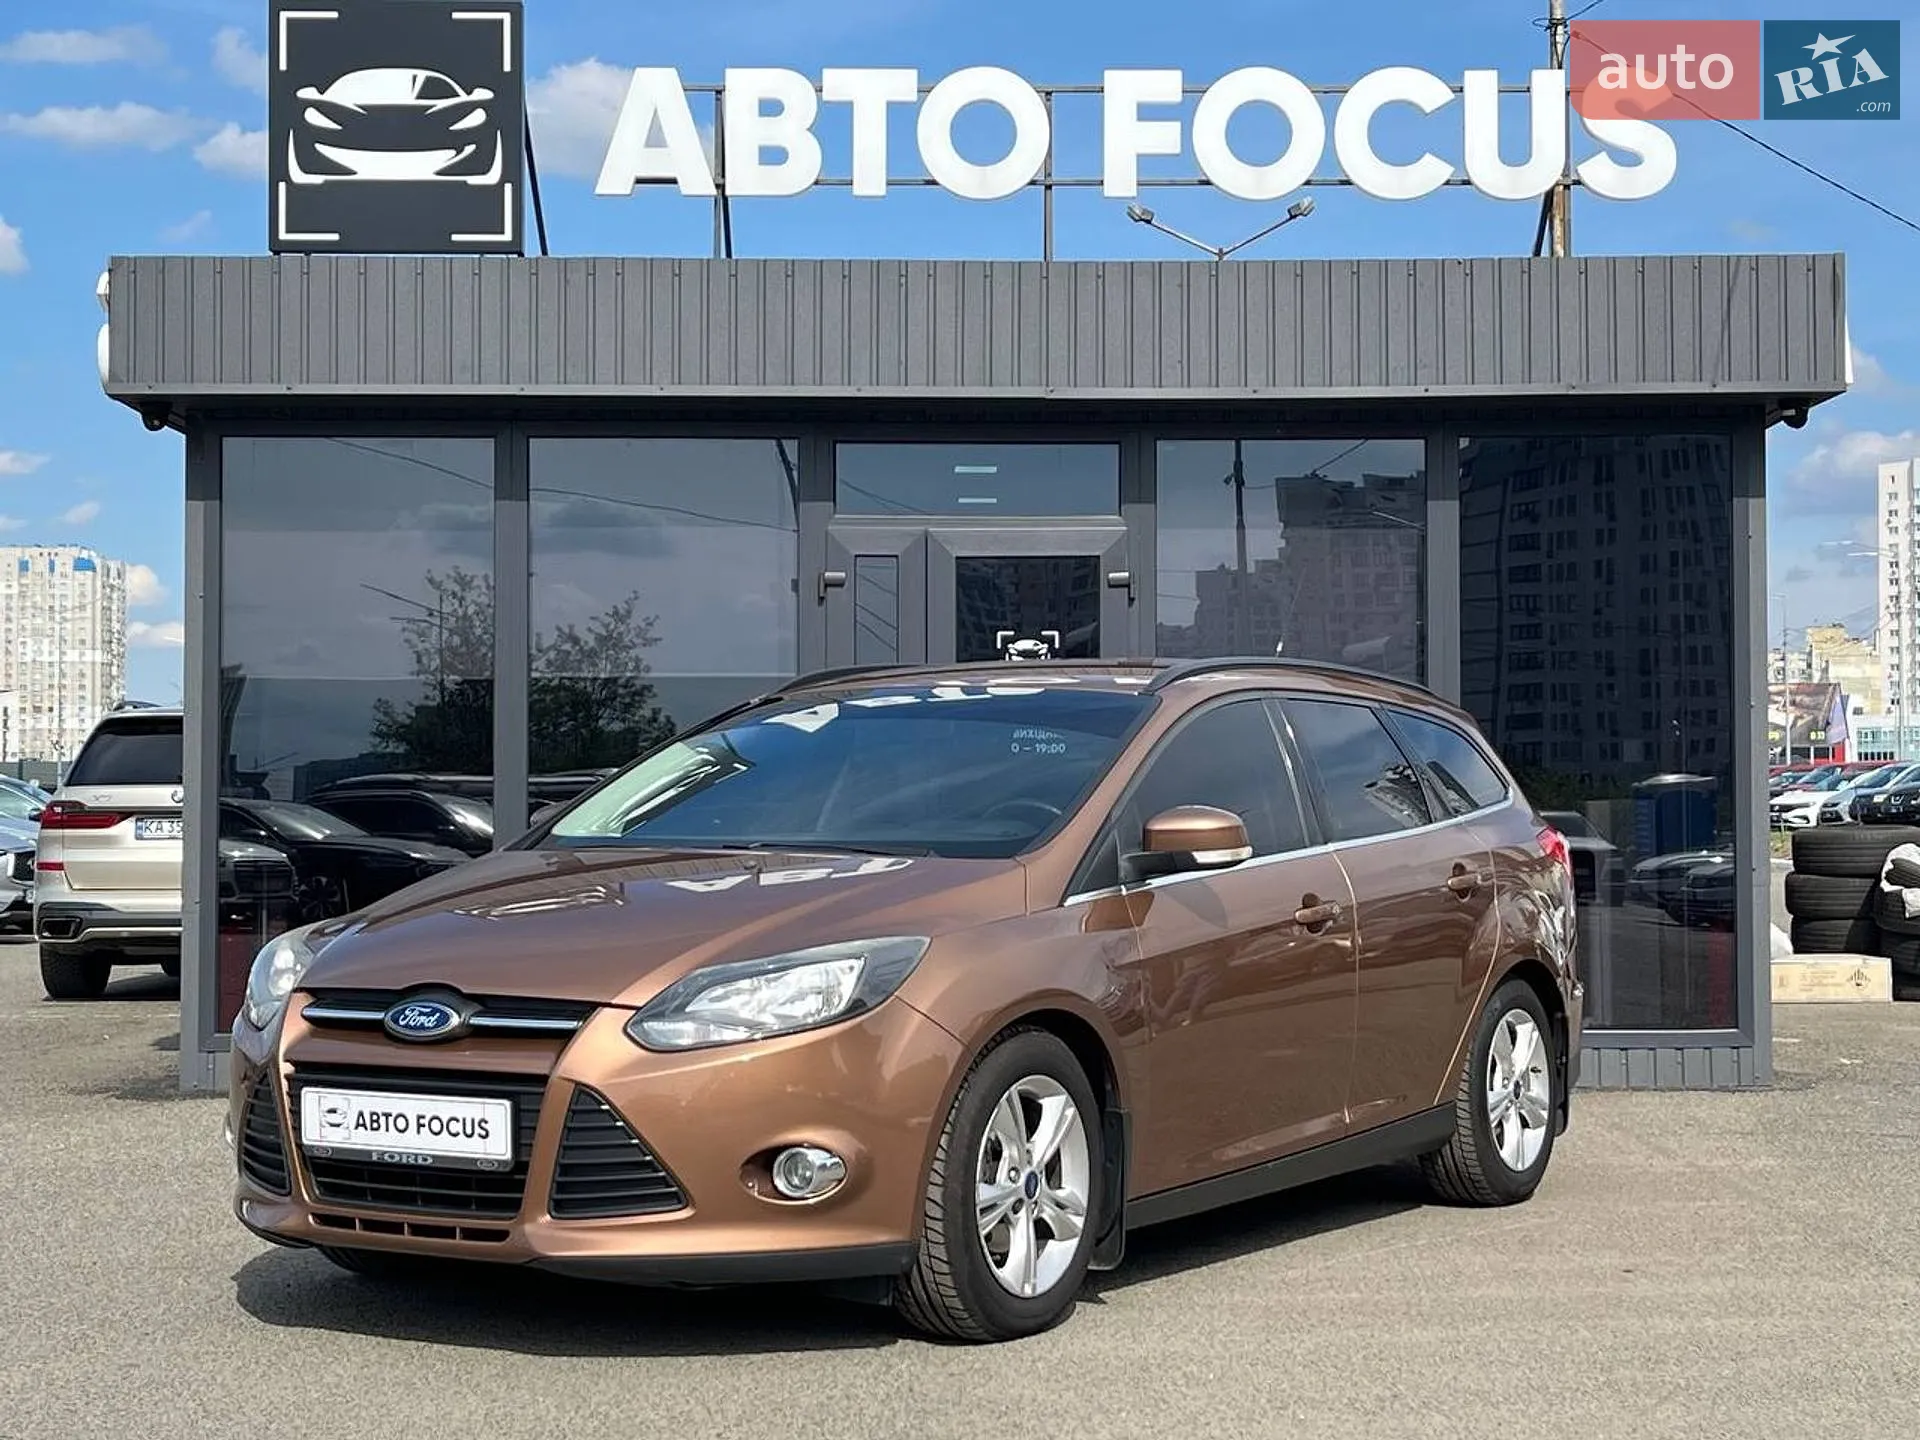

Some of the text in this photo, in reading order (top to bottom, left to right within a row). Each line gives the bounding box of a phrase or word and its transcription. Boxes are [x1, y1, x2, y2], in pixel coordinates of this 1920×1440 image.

[594, 66, 1677, 200] АВТО FOCUS
[1035, 743, 1066, 753] 19:00
[399, 1006, 440, 1028] Ford
[354, 1109, 490, 1140] АВТО FOCUS
[371, 1151, 434, 1166] FORD
